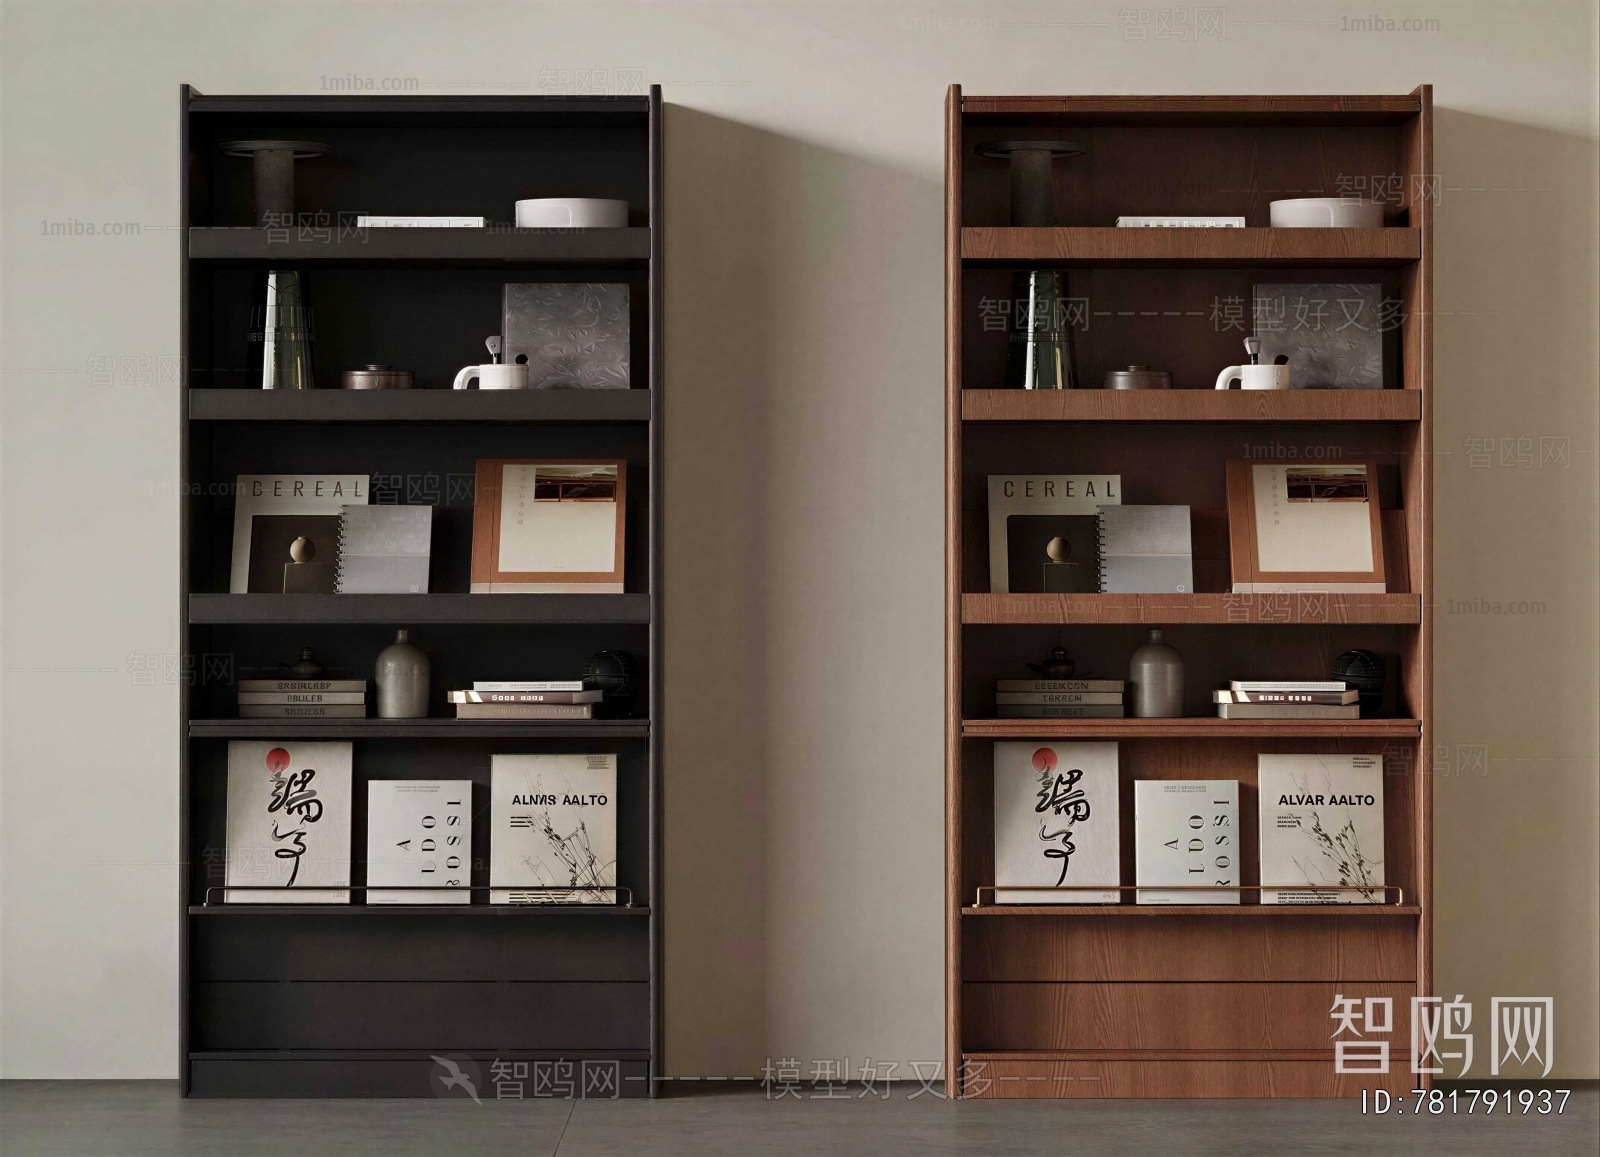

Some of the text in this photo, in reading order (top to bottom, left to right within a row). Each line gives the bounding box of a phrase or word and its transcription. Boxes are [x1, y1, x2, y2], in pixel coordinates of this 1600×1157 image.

[1003, 480, 1116, 498] CEREAL
[562, 794, 608, 806] AALTO
[1278, 794, 1375, 806] ALVAR AALTO
